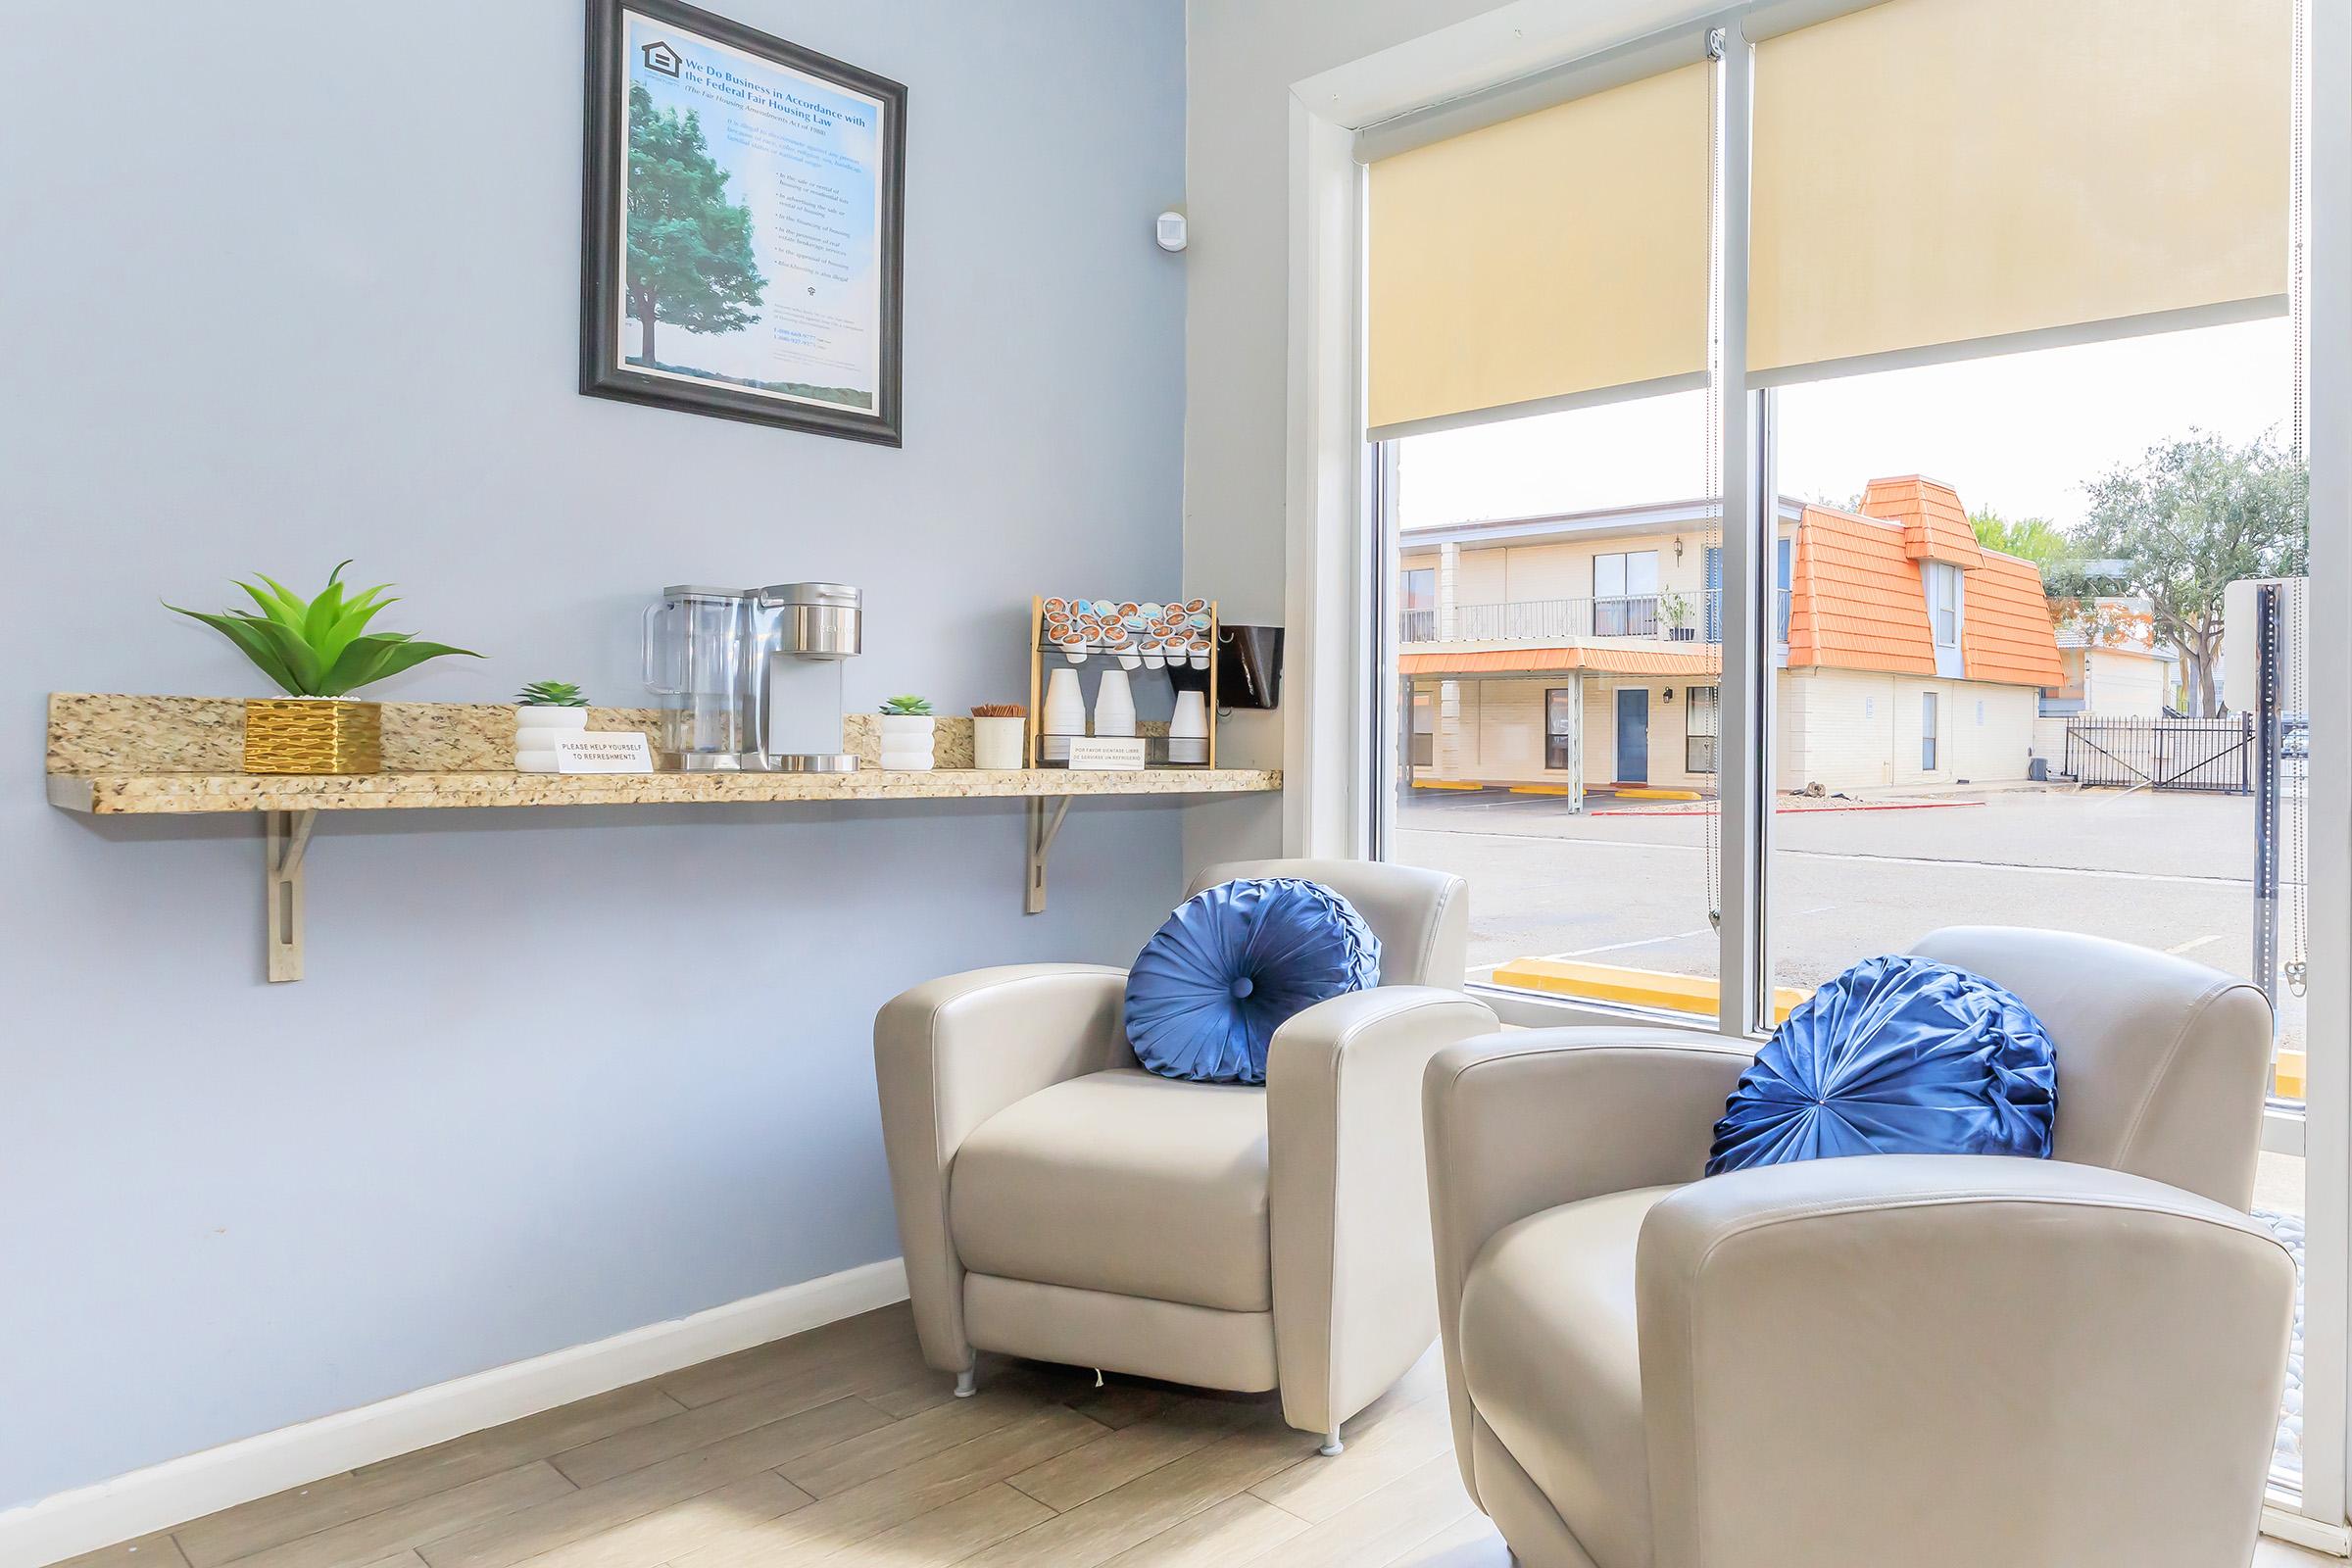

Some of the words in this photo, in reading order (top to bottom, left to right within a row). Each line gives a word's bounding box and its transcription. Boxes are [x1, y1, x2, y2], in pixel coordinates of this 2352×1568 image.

[684, 84, 702, 94] (The
[702, 90, 714, 100] Fair
[715, 94, 745, 111] Housing
[745, 105, 789, 124] Amendments
[789, 120, 801, 128] Act
[685, 58, 704, 73] We
[706, 65, 722, 78] Do
[725, 72, 770, 95] Business
[772, 88, 783, 100] in
[785, 93, 843, 120] Accordance
[844, 116, 866, 127] with
[685, 71, 703, 84] the
[706, 77, 745, 98] Federal
[747, 91, 766, 106] Fair
[768, 98, 811, 122] Housing
[812, 114, 832, 127] Law
[608, 743, 643, 752] YOURSELF
